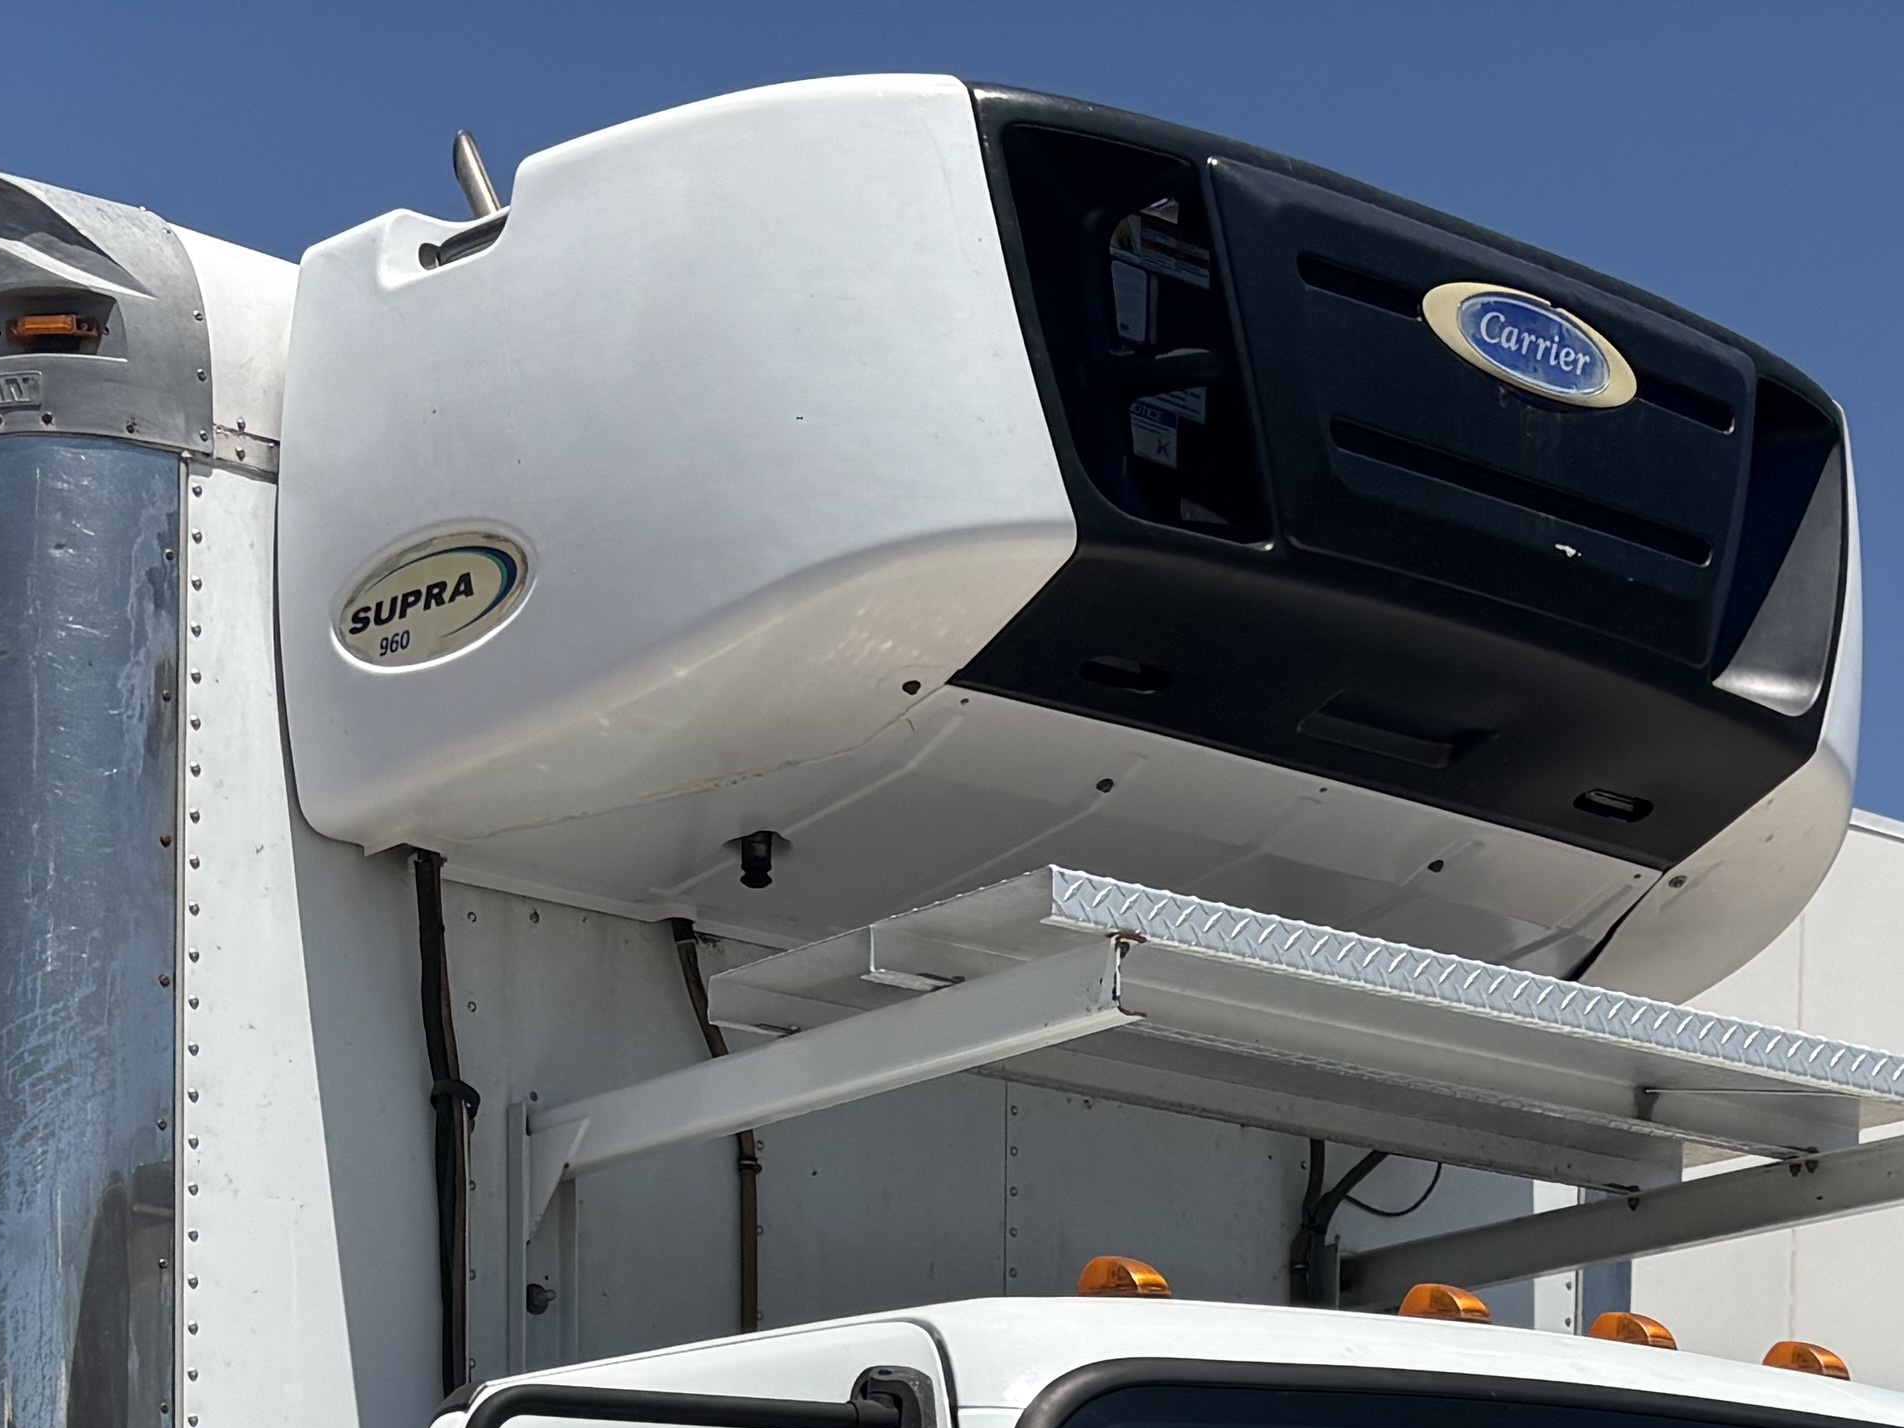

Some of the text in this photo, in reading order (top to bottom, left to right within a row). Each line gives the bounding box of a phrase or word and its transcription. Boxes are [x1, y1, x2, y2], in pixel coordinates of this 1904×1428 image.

[1479, 311, 1591, 375] Carrier
[348, 571, 474, 635] SUPRA
[379, 629, 411, 657] 960
